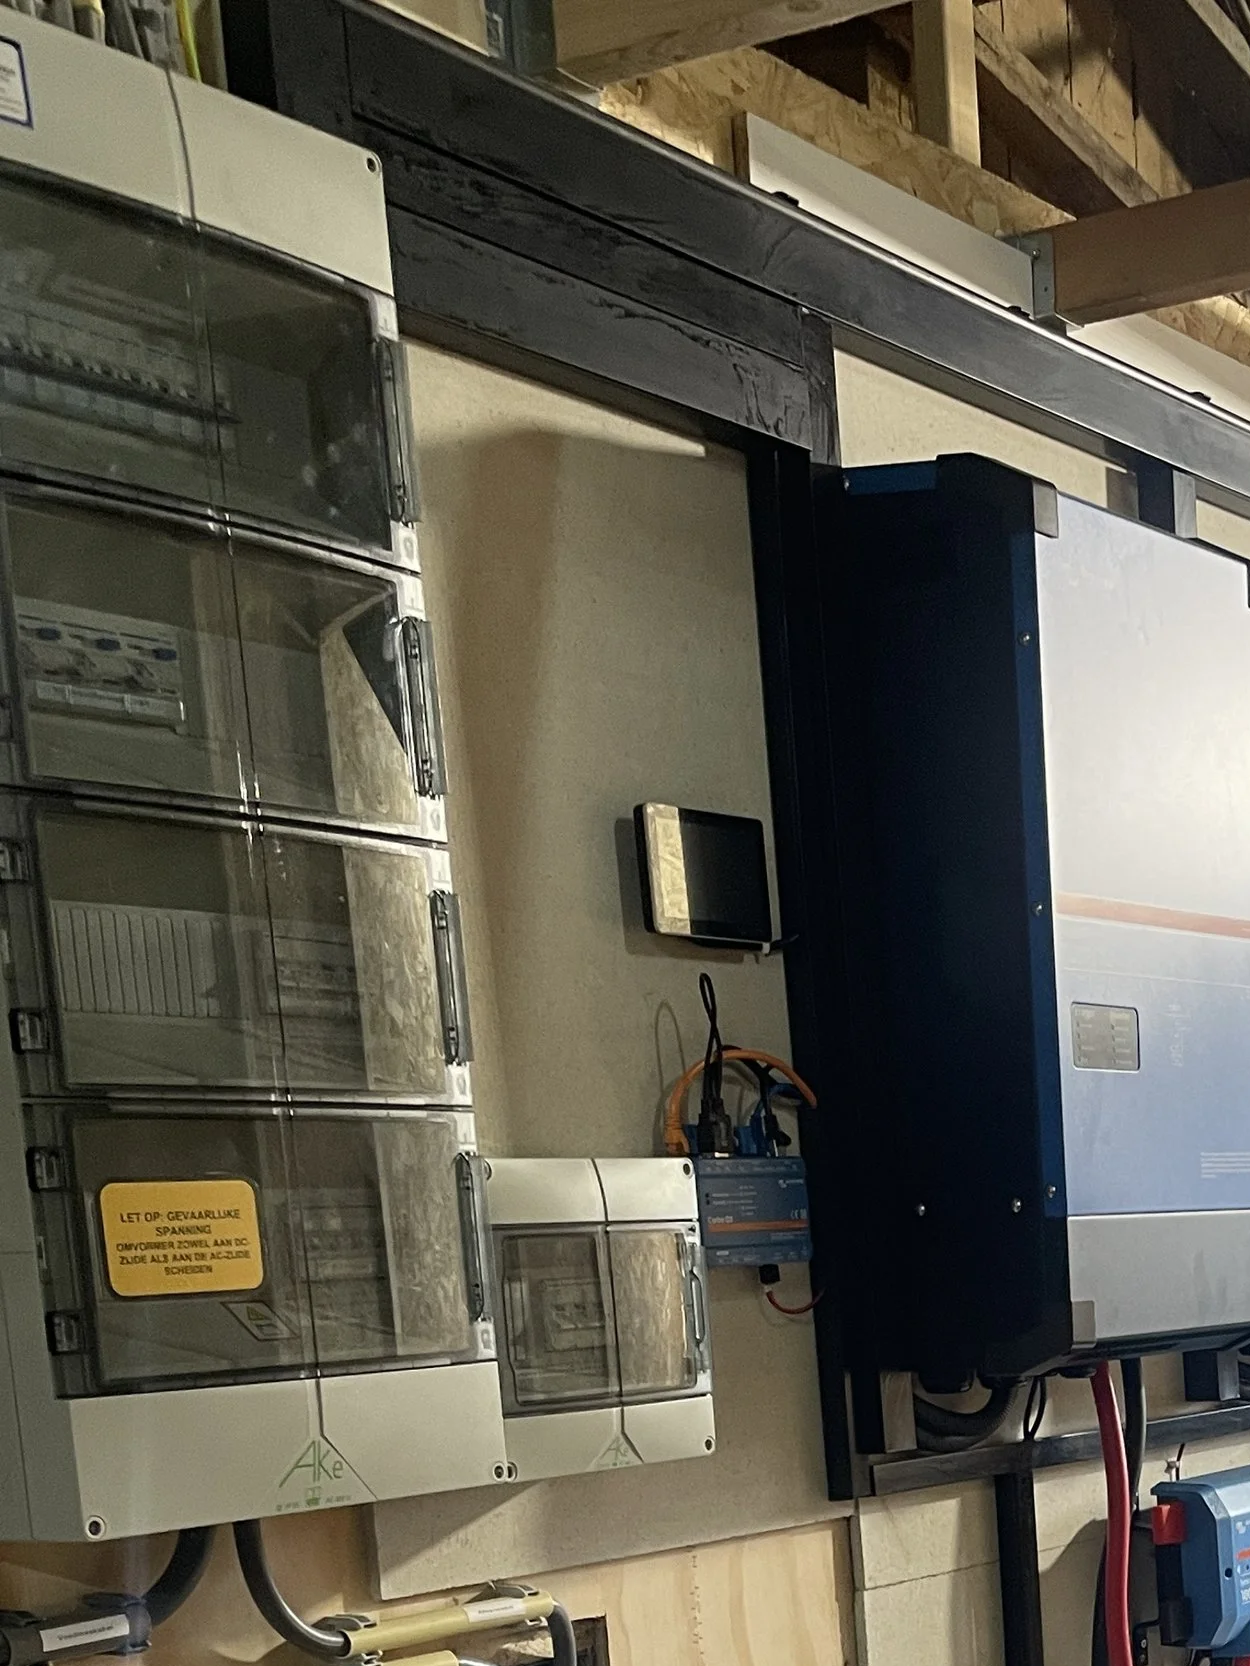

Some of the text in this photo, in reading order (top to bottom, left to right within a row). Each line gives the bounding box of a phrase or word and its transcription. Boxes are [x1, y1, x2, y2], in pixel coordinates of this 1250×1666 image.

[119, 1212, 140, 1223] LET
[167, 1209, 241, 1222] GEVAARLIJKE
[155, 1224, 212, 1237] SPANNING
[213, 1237, 233, 1248] AAN
[150, 1252, 169, 1264] ALS
[172, 1251, 193, 1263] AAN
